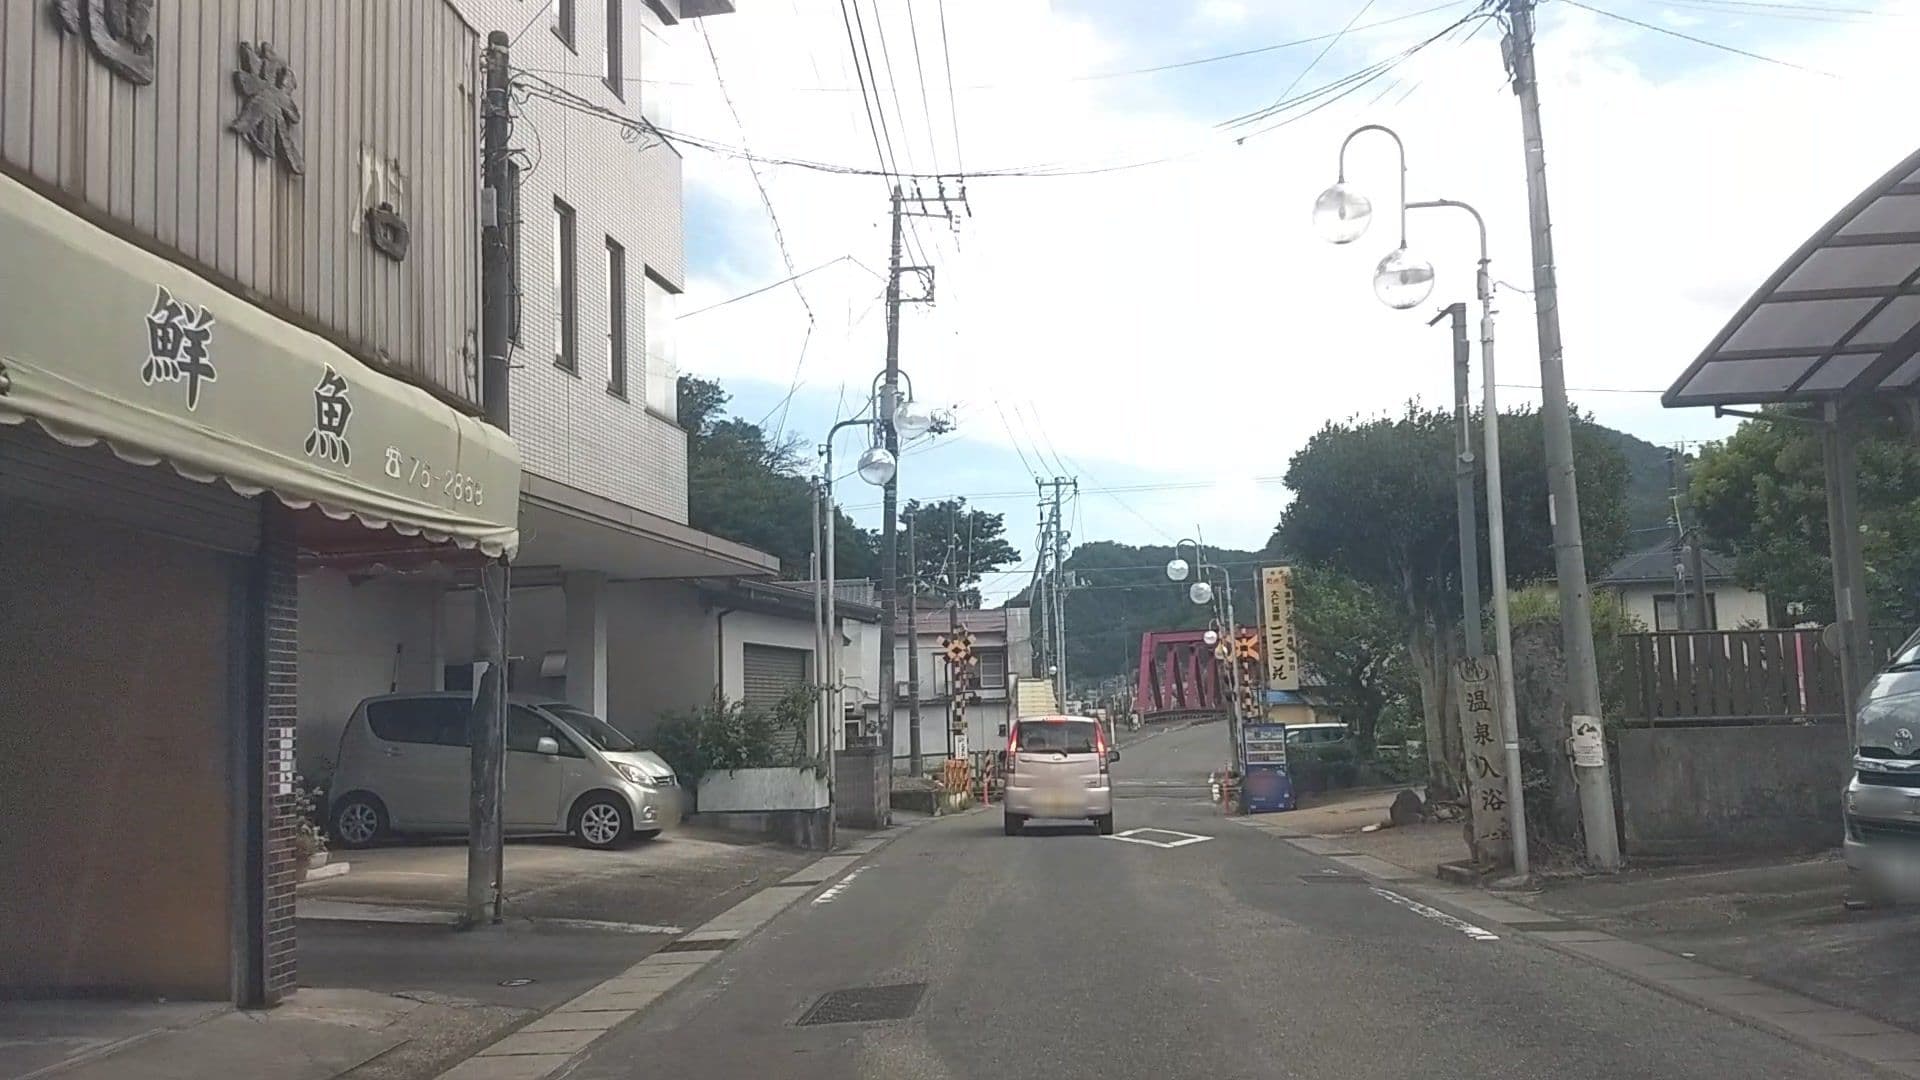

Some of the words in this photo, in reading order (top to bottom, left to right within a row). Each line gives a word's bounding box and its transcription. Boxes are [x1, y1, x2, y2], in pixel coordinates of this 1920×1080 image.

[141, 284, 352, 467] 鮮魚
[1466, 690, 1506, 811] 温泉入浴
